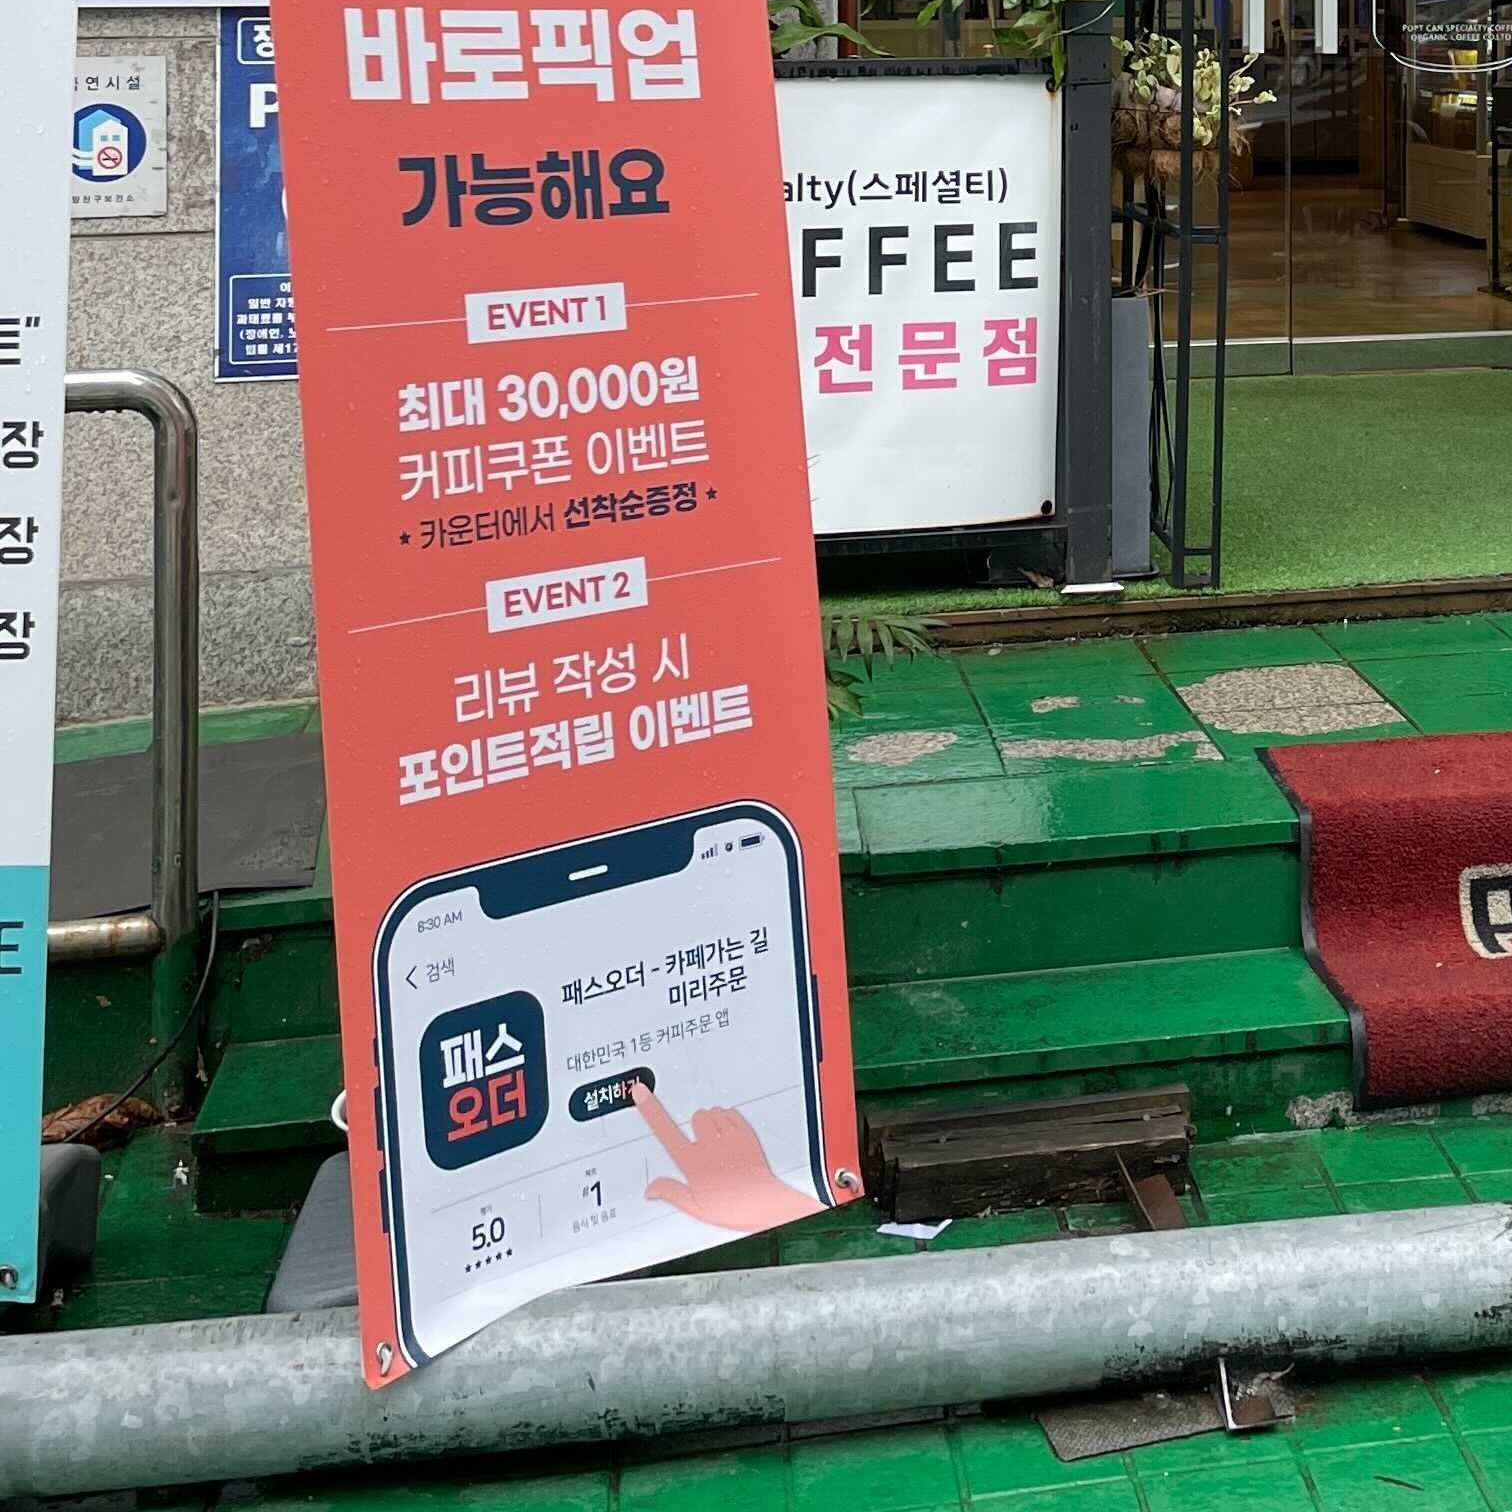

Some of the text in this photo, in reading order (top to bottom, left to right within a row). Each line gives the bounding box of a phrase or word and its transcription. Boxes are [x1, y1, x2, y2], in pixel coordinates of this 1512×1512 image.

[343, 6, 701, 105] 바로픽업
[1426, 24, 1444, 33] CAN
[398, 148, 670, 228] 가능해요
[487, 296, 607, 330] EVENT 1
[814, 317, 1038, 394] 전문점
[399, 355, 700, 432] 최대 30,000원
[399, 419, 710, 501] 커피쿠폰 이벤트
[420, 481, 698, 550] 카운터에서 선착순증정
[504, 571, 631, 617] EVENT 2
[454, 633, 690, 723] 리뷰 작성 시
[399, 684, 753, 806] 포인트적립 이벤트
[443, 909, 463, 925] AM
[426, 957, 456, 983] 검색
[562, 961, 646, 1005] 패스오더
[664, 936, 745, 976] 카페가는
[750, 926, 769, 954] 길
[669, 965, 748, 1007] 미리주문
[439, 1022, 526, 1088] 패스
[567, 1040, 626, 1072] 대한민국
[631, 1032, 654, 1054] 1등
[656, 1013, 713, 1045] 커피주문
[447, 1069, 528, 1143] 오더
[472, 1216, 505, 1251] 5.0
